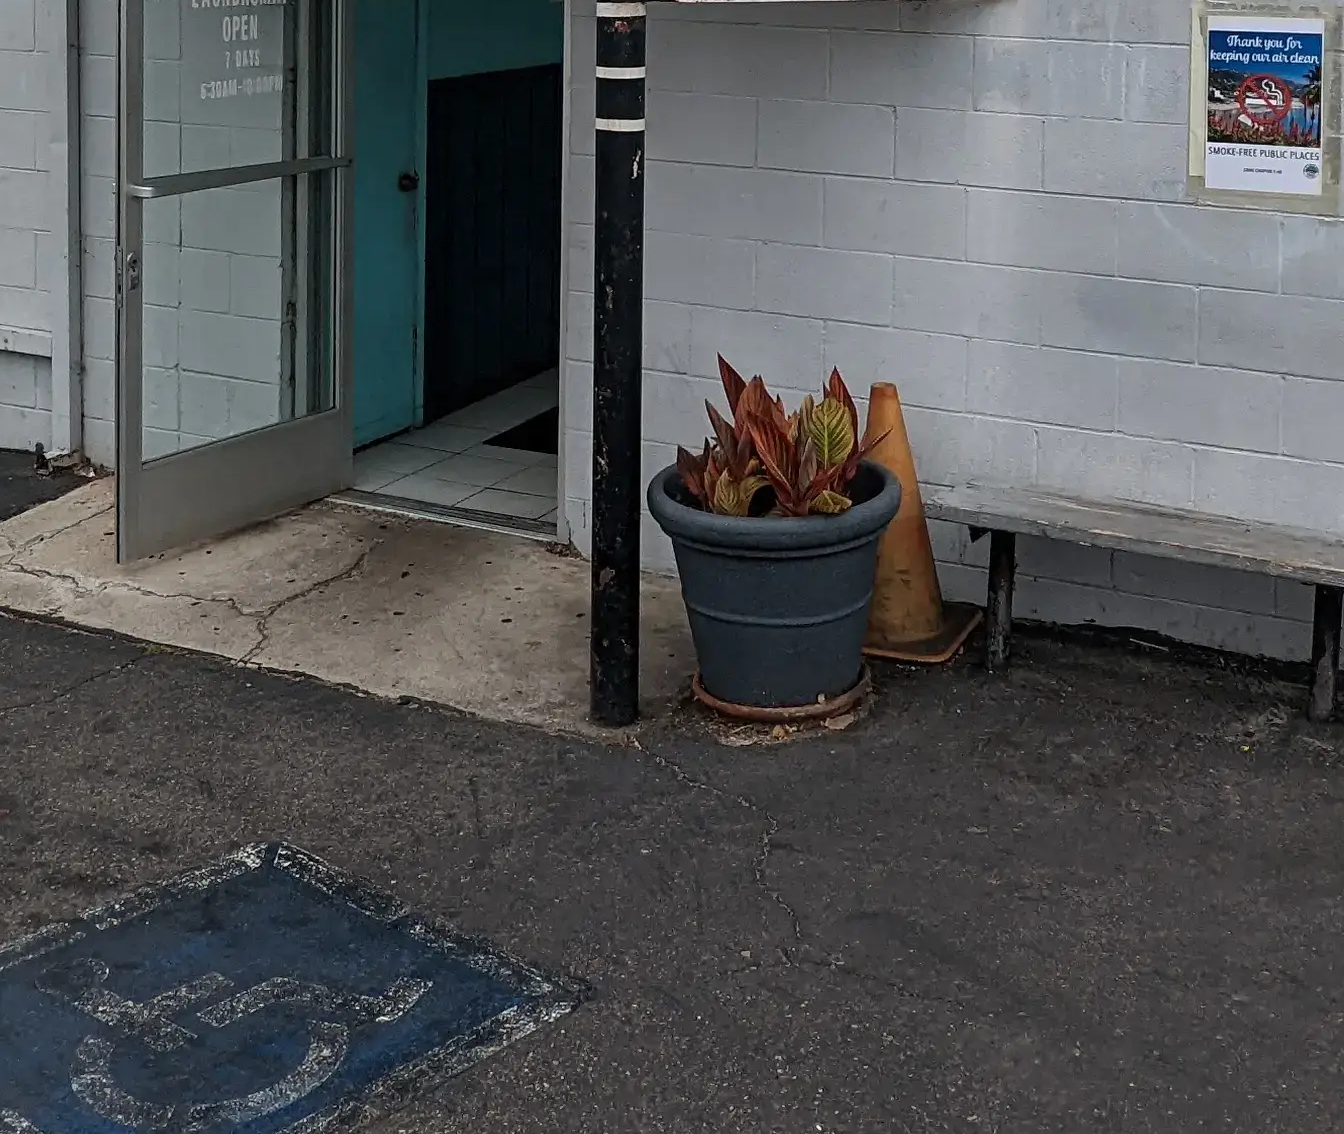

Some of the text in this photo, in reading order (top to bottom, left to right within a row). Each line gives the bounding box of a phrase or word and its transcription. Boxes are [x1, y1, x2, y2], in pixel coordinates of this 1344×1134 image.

[222, 14, 259, 42] OPEN
[1226, 34, 1303, 51] Thank you for
[235, 49, 260, 69] DAYS
[1210, 50, 1320, 65] keeping our air clean
[1208, 146, 1320, 161] SMOKE-FREE PUBLIC PLACES
